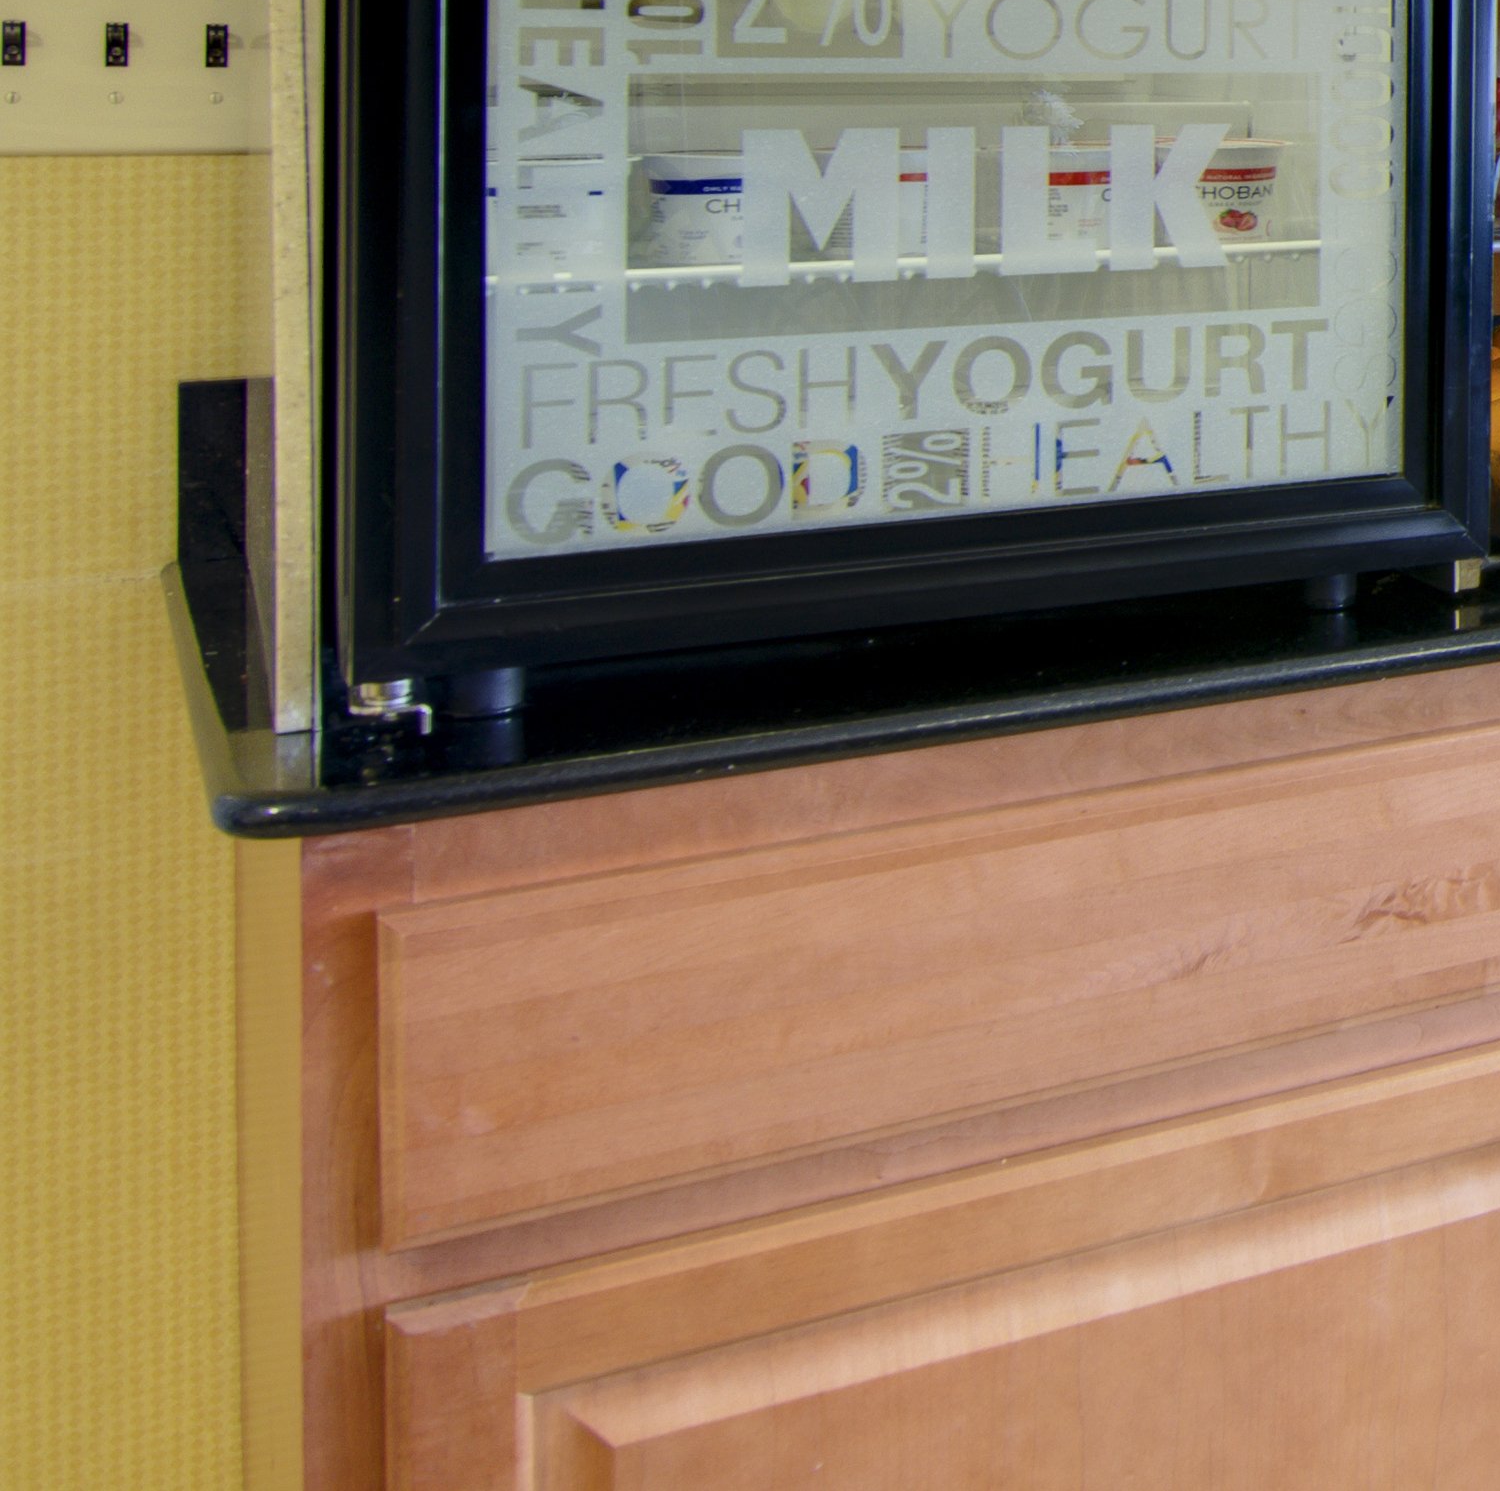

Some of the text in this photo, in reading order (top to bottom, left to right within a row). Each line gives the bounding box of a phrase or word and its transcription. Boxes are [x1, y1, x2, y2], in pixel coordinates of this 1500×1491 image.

[741, 122, 1232, 287] MILK
[1196, 184, 1274, 200] HOBAN
[520, 318, 1329, 450] FRESH YOGURT
[505, 395, 1395, 546] GOOD 2% HEALTHY
